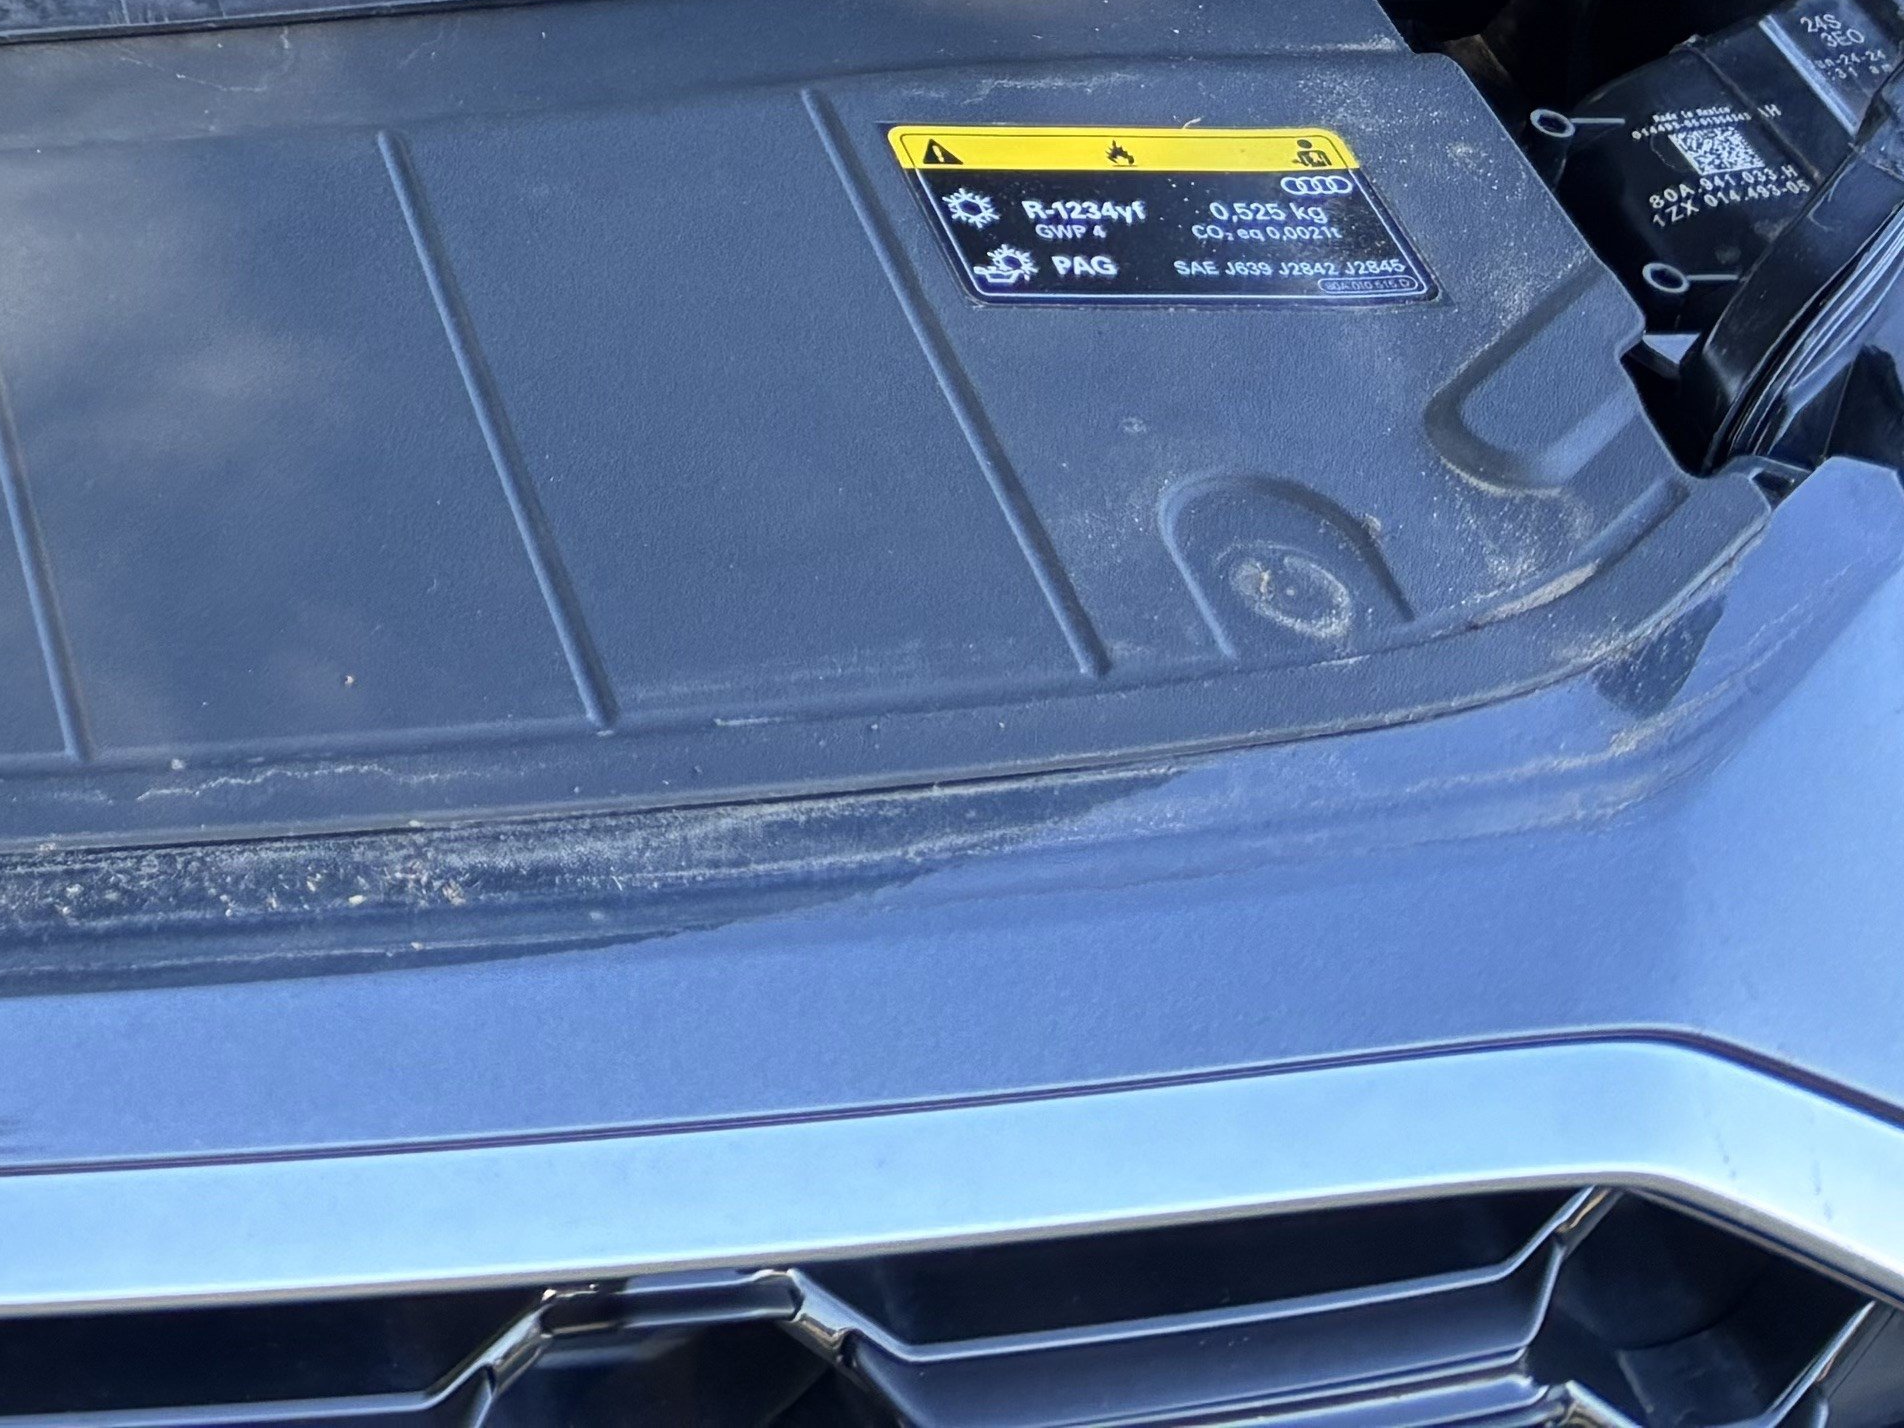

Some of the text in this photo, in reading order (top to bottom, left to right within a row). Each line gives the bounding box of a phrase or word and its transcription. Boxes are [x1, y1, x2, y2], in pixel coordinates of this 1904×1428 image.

[1800, 13, 1842, 33] 24S
[1022, 200, 1144, 223] R-1234yf
[1209, 202, 1327, 223] 0,525 kg
[1035, 224, 1106, 238] GWP 4
[1236, 228, 1264, 241] eq
[1051, 255, 1117, 275] PAG
[1173, 258, 1404, 276] SAE J639 J2842 J2845
